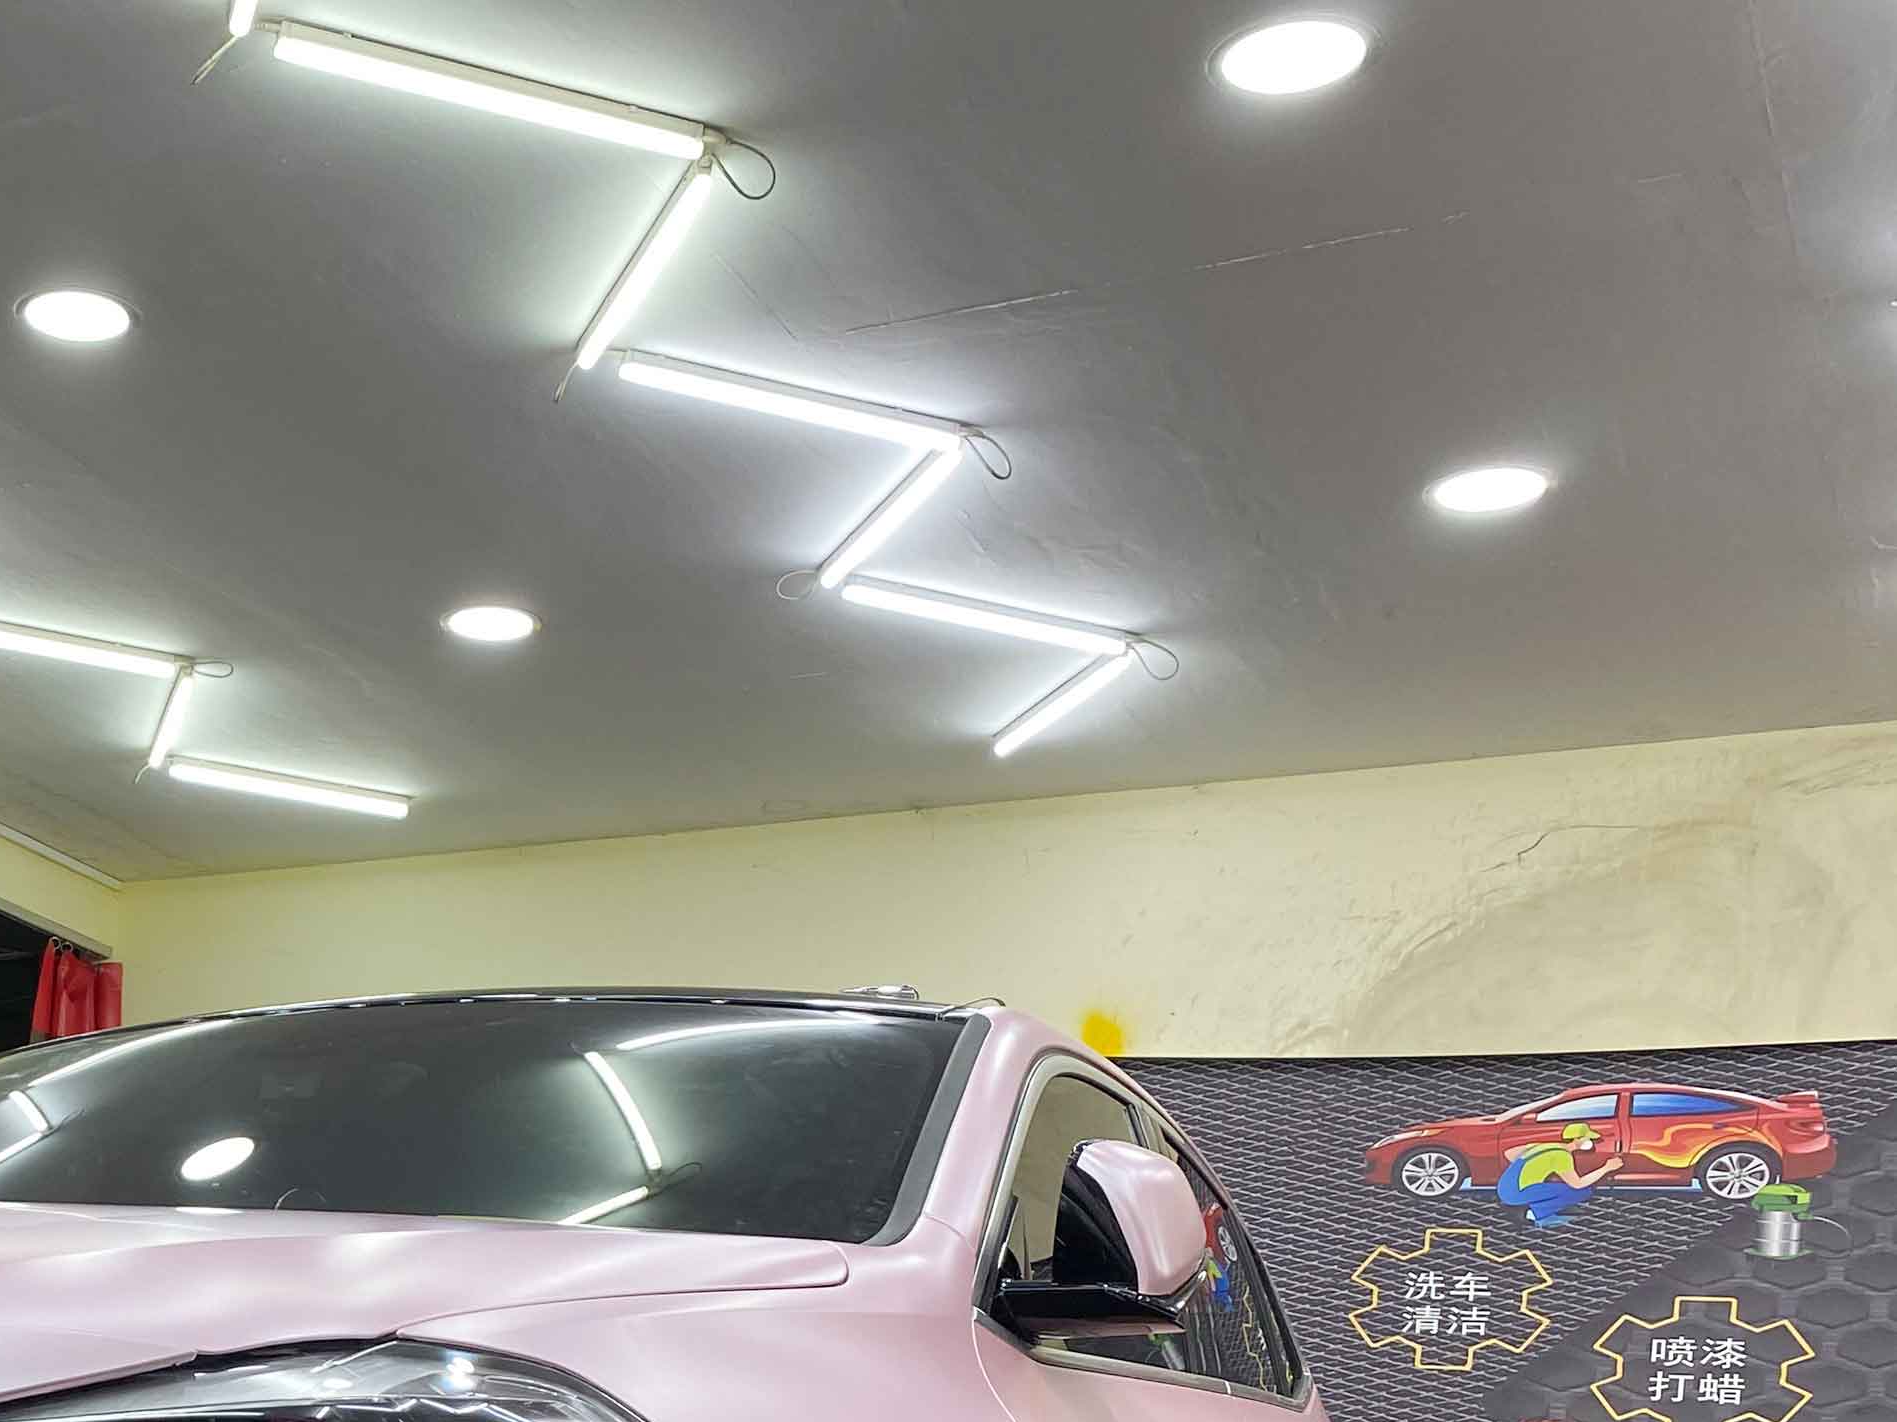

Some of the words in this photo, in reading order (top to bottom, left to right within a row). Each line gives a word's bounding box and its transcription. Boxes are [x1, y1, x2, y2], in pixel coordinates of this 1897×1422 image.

[1405, 1271, 1491, 1301] 洗车
[1402, 1305, 1491, 1335] 清洁
[1650, 1336, 1747, 1369] 喷漆
[1648, 1371, 1745, 1405] 打蜡
